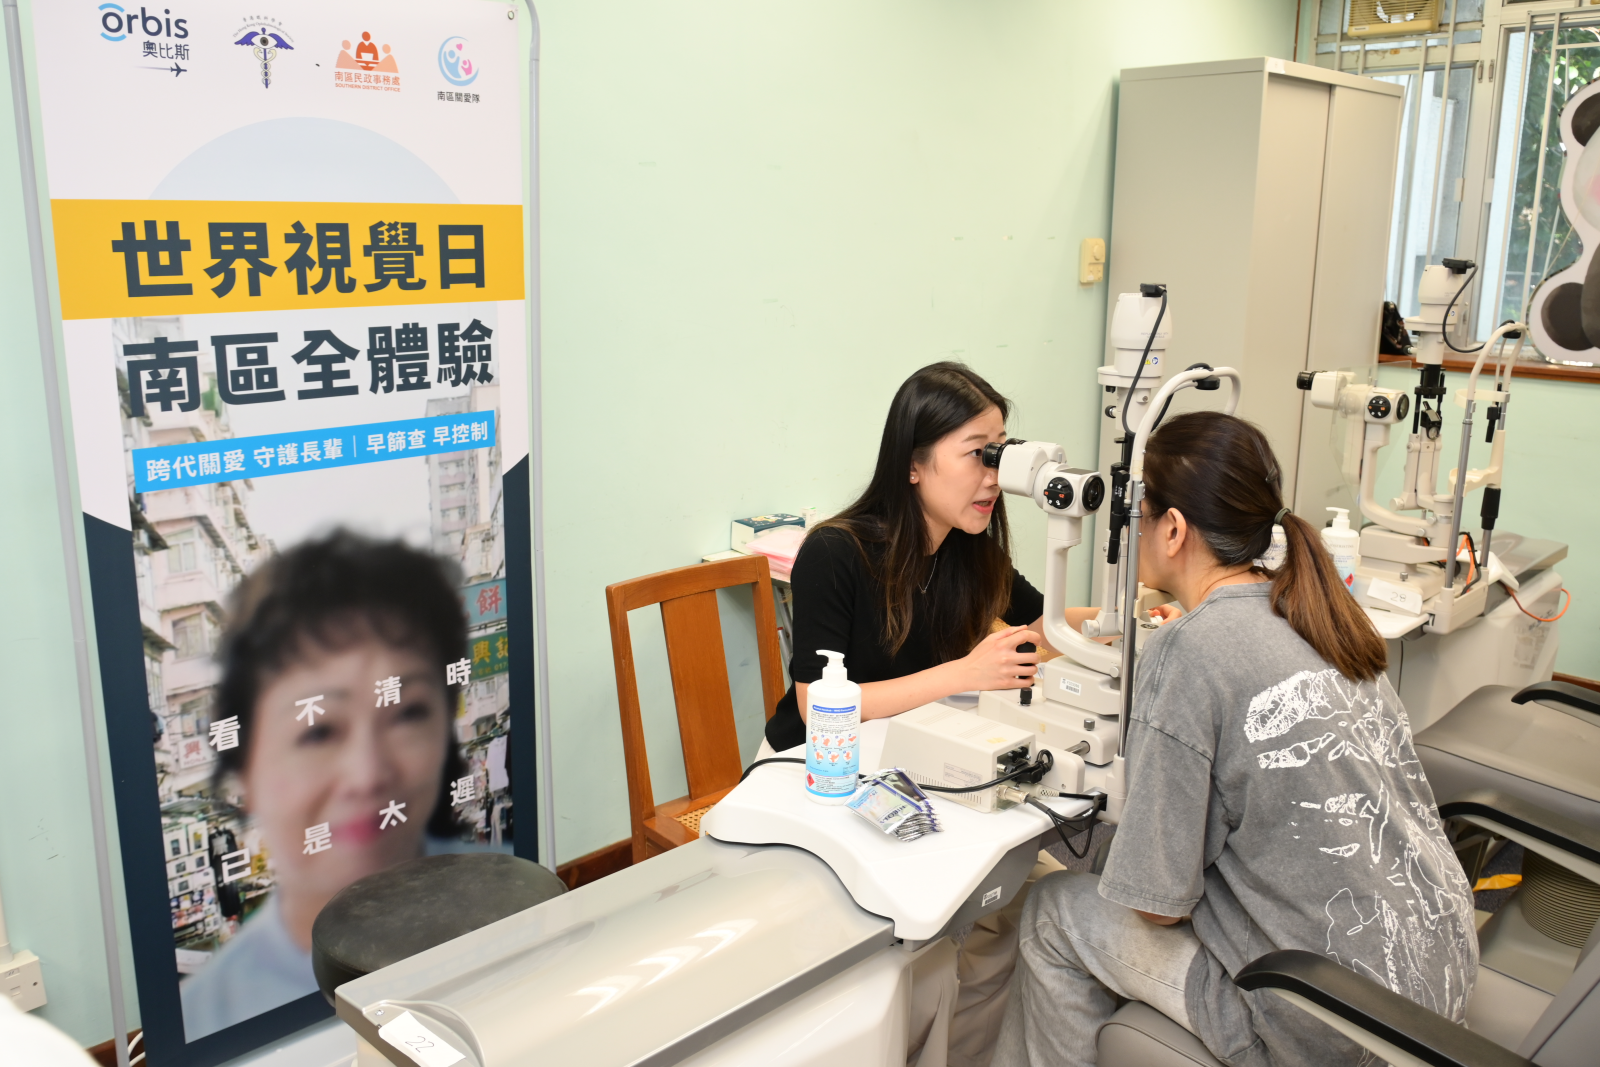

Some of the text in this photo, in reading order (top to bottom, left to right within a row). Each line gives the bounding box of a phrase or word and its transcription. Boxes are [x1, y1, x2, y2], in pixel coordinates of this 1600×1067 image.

[101, 6, 188, 39] orbis
[142, 39, 189, 61] 奧比斯
[334, 70, 401, 87] 南區民政事務處
[334, 82, 361, 90] SOUTHERN
[437, 91, 480, 104] 南區關愛隊
[112, 220, 486, 298] 世界視覺日
[123, 318, 494, 417] 南區全體驗
[146, 420, 488, 482] 跨代關愛 守護長輩 早篩查 早控制
[1390, 591, 1407, 603] 28
[209, 715, 241, 752] 看
[295, 694, 326, 726] 不
[374, 676, 402, 708] 清
[446, 658, 472, 686] 時
[222, 774, 475, 883] 已 是 太 遲
[404, 1035, 435, 1053] 22
